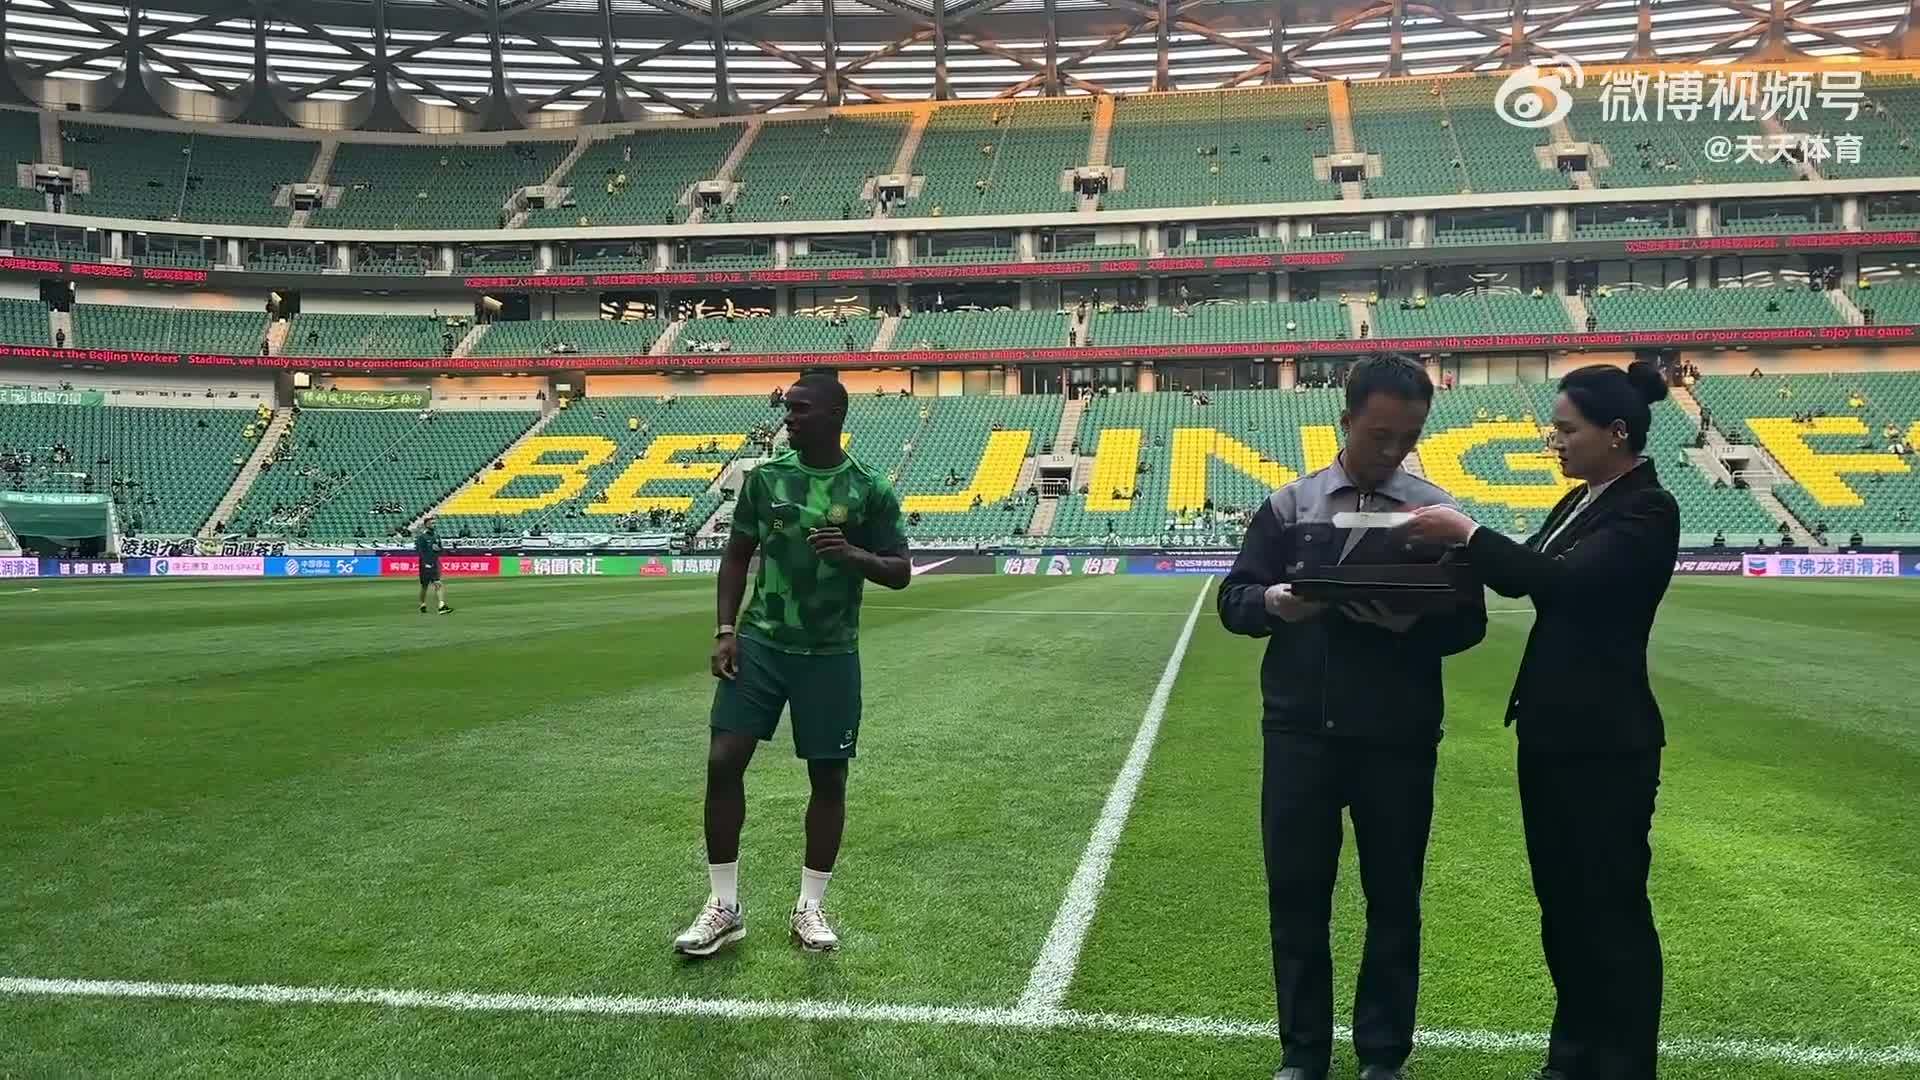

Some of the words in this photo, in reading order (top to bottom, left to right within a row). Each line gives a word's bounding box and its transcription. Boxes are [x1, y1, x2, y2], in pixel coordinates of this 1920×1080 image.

[12, 347, 49, 357] match
[52, 350, 64, 358] at
[67, 349, 87, 359] the
[89, 350, 129, 363] Beijing
[187, 354, 237, 366] Stadium,
[239, 358, 254, 367] we
[257, 357, 290, 369] kindly
[311, 359, 332, 369] you
[334, 359, 346, 368] to
[347, 358, 360, 368] be
[361, 358, 430, 369] conscientious
[875, 352, 900, 362] from
[900, 350, 945, 362] climbing
[1463, 336, 1494, 349] good
[1552, 334, 1570, 344] No
[1666, 331, 1689, 345] you
[1711, 330, 1738, 343] your
[1819, 327, 1852, 340] Enjoy
[1855, 326, 1876, 337] the
[1877, 326, 1915, 339] game.
[436, 423, 1582, 515] BEJING
[0, 560, 36, 575] 润滑油
[1779, 558, 1895, 576] 雪佛龙润滑油
